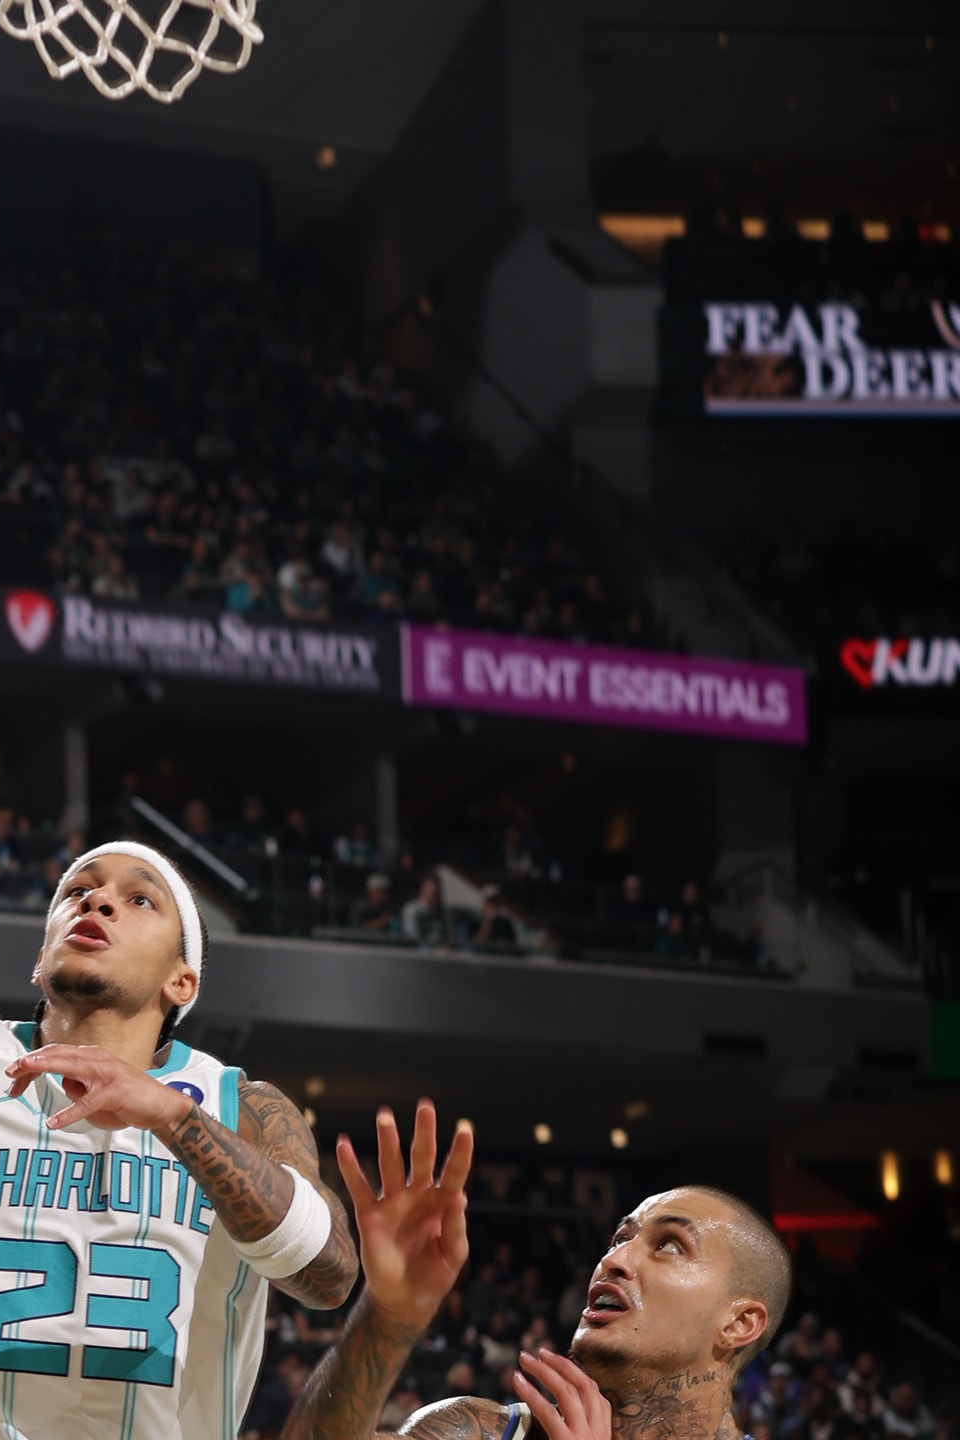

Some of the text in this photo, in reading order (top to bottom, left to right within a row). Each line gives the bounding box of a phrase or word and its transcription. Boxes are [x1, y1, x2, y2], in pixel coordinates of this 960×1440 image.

[704, 302, 867, 355] FEAR
[462, 646, 790, 726] EVENT ESSENTIALS
